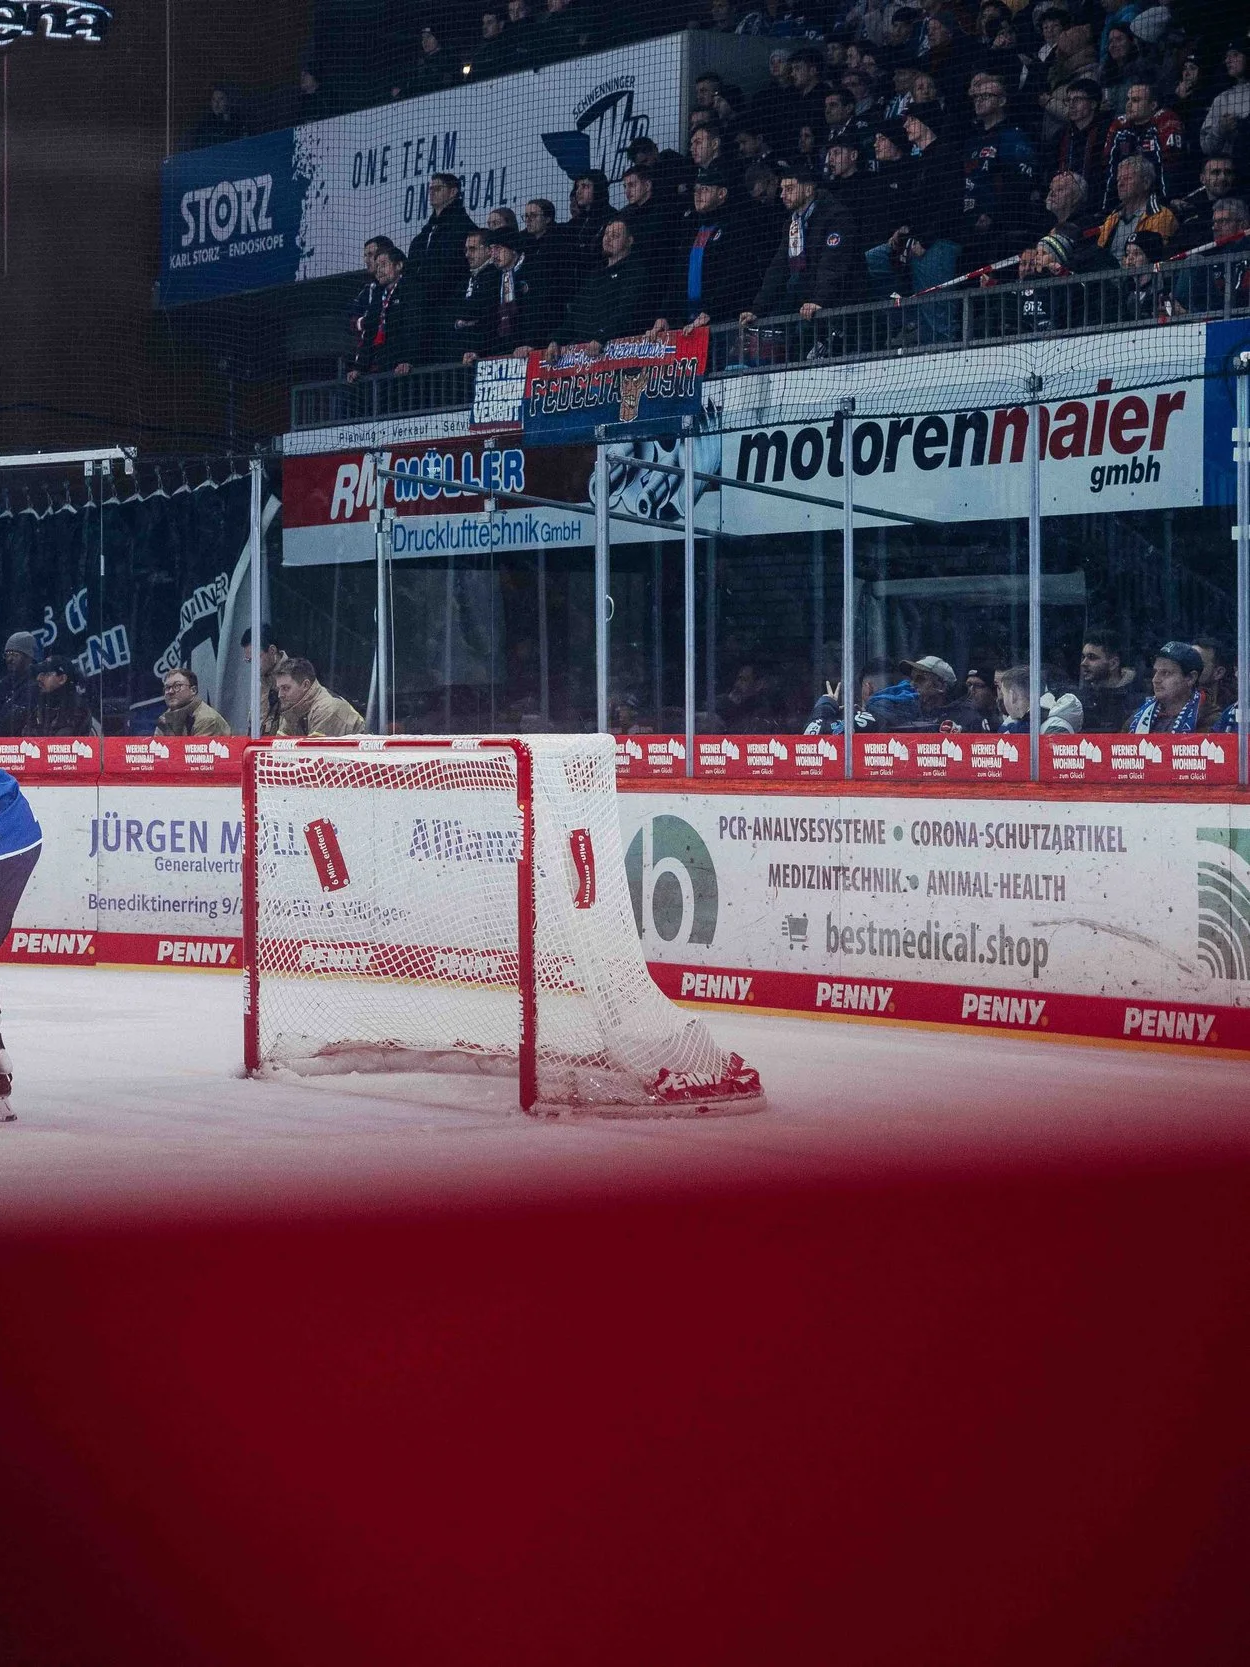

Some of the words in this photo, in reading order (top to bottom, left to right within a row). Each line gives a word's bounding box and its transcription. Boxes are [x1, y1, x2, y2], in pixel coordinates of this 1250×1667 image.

[573, 75, 636, 119] SCHWENNINGER
[352, 145, 392, 189] ONE
[403, 131, 464, 178] TEAM.
[403, 182, 433, 223] ON
[180, 173, 273, 247] STORZ
[170, 253, 191, 269] KARL
[193, 246, 220, 265] STORZ
[229, 233, 284, 257] ENDOSKOPE
[339, 431, 376, 443] Planung
[393, 423, 428, 437] Verkauf
[736, 379, 1186, 484] motorenmaier
[394, 447, 525, 502] MÜLLER
[1089, 455, 1161, 493] gmbh
[394, 513, 539, 551] Drucklufttechnik
[540, 517, 581, 543] GmbH
[47, 744, 71, 754] WERNER
[125, 744, 148, 753] WERNER
[185, 744, 207, 753] WERNER
[648, 744, 667, 753] WERNER
[700, 744, 720, 754] WERNER
[747, 744, 768, 754] WERNER
[795, 744, 817, 754] WERNER
[864, 743, 887, 754] WERNER
[917, 744, 940, 754] WERNER
[971, 744, 996, 755] WERNER
[1052, 744, 1078, 756] WERNER
[1111, 744, 1137, 756] WERNER
[1172, 744, 1199, 756] WERNER
[47, 755, 77, 763] WOHNBAU
[126, 754, 154, 763] WOHNBAU
[185, 754, 214, 763] WOHNBAU
[648, 756, 673, 765] WOHNBAU
[700, 756, 726, 766] WOHNBAU
[747, 756, 774, 766] WOHNBAU
[795, 756, 823, 766] WOHNBAU
[864, 756, 893, 767] WOHNBAU
[917, 756, 947, 767] WOHNBAU
[971, 757, 1002, 768] WOHNBAU
[1053, 758, 1085, 769] WOHNBAU
[1111, 758, 1144, 770] WOHNBAU
[1172, 758, 1206, 770] WOHNBAU
[89, 811, 208, 858] JÜRGEN
[719, 815, 886, 845] PCR-ANALYSESYSTEME
[910, 820, 1128, 853] CORONA-SCHUTZARTIKEL
[314, 825, 330, 859] entfernt
[583, 864, 591, 903] entfernt
[768, 863, 902, 893] MEDIZINTECHNIK
[926, 869, 1066, 901] ANIMAL-HEALTH
[88, 893, 217, 919] Benediktinerring
[825, 912, 1050, 978] bestmedical.shop
